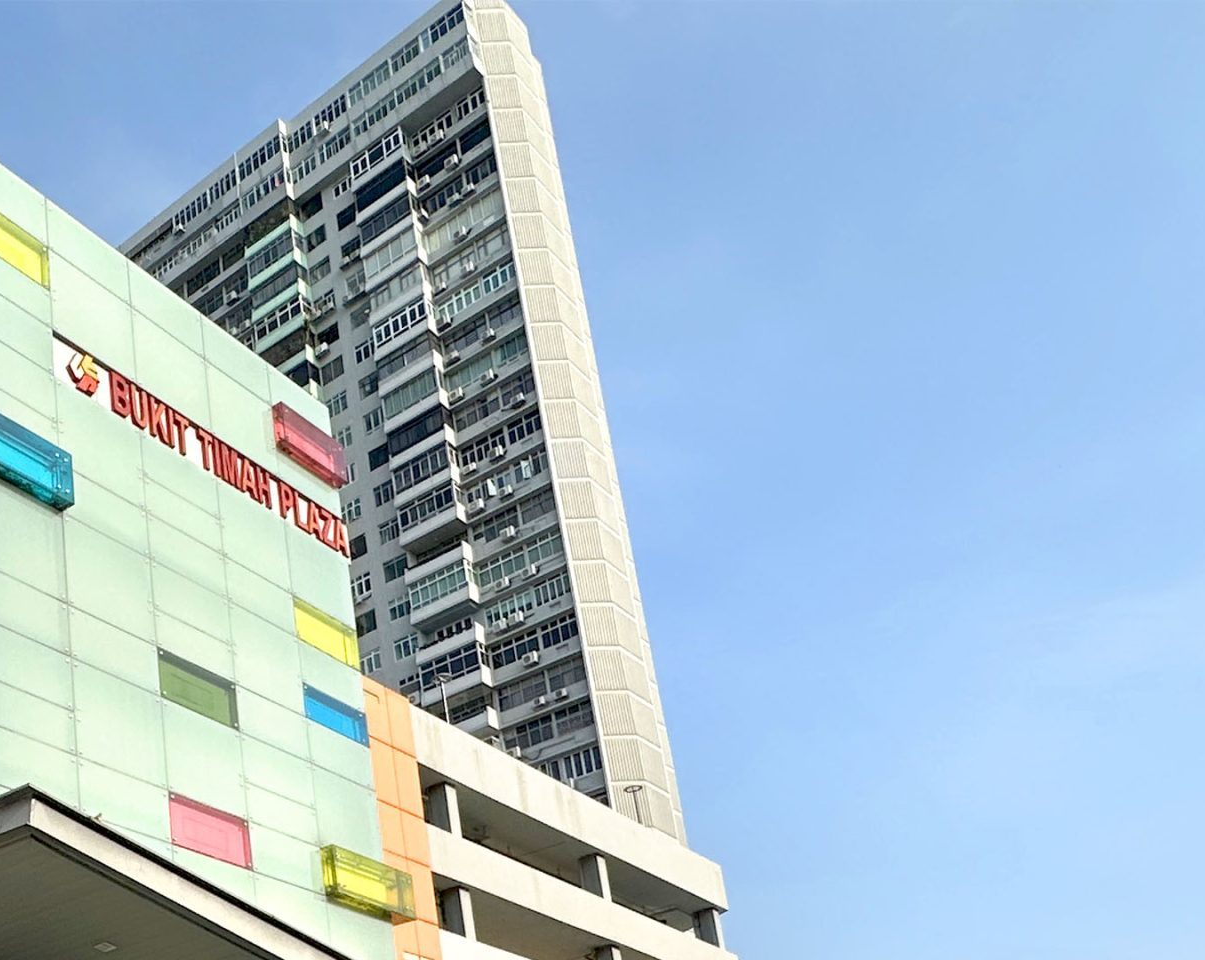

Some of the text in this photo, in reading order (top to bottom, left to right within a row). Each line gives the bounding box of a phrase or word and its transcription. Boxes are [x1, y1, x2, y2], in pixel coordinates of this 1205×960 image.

[108, 370, 351, 558] BUKIT TIMAH PLAZA
